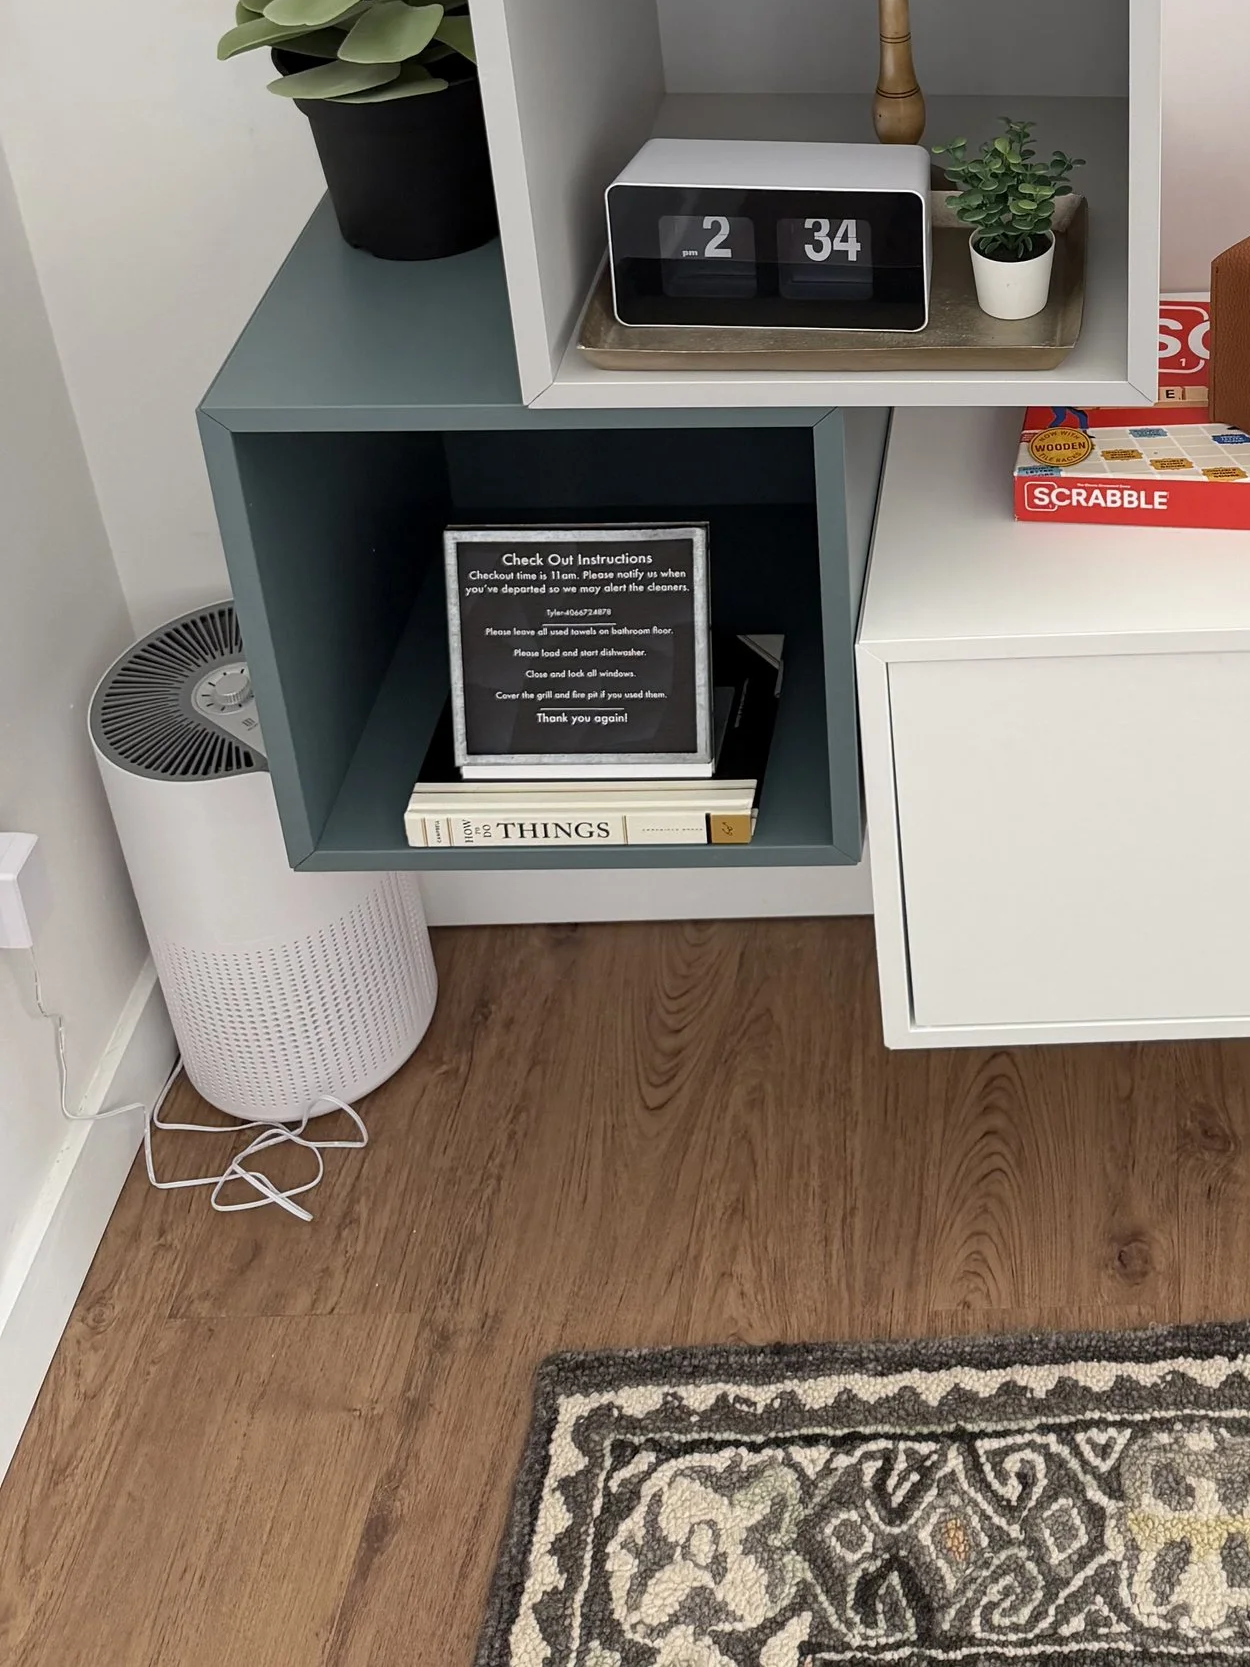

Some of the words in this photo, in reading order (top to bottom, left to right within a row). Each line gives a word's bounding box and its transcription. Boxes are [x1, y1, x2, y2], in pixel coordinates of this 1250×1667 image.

[682, 250, 698, 258] pm
[702, 216, 732, 258] 2
[804, 218, 861, 262] 34
[1060, 430, 1079, 440] WITH
[1035, 442, 1086, 452] WOODEN
[1033, 487, 1169, 509] SCRABBLE
[502, 553, 543, 566] Check
[548, 553, 573, 566] Out
[578, 552, 653, 565] Instructions
[469, 571, 514, 581] Checkout
[516, 572, 537, 580] time
[539, 572, 547, 580] is
[551, 571, 580, 580] 11am.
[583, 571, 614, 580] Please
[617, 569, 644, 581] notify
[647, 571, 658, 579] us
[660, 569, 686, 578] when
[465, 584, 498, 596] you've
[501, 584, 546, 596] departed
[549, 586, 560, 594] so
[563, 586, 577, 594] we
[580, 586, 600, 595] may
[604, 583, 627, 592] alert
[629, 583, 644, 592] the
[647, 583, 690, 592] cleaners.
[485, 628, 511, 636] Please
[513, 628, 535, 636] leave
[571, 627, 597, 635] towels
[611, 626, 650, 635] bathroom
[652, 626, 673, 634] floor.
[513, 649, 539, 657] Please
[541, 649, 560, 657] load
[563, 649, 578, 657] and
[580, 649, 599, 657] start
[600, 648, 647, 657] dishwasher.
[525, 670, 548, 678] Close
[550, 670, 566, 678] and
[568, 670, 584, 678] lock
[599, 669, 636, 677] windows.
[495, 691, 519, 700] Cover
[521, 691, 535, 699] the
[536, 690, 553, 701] grill
[555, 691, 570, 699] and
[572, 690, 585, 699] fire
[587, 690, 598, 701] pit
[600, 690, 606, 699] if
[607, 691, 622, 701] you
[624, 690, 643, 699] used
[645, 690, 668, 699] them.
[536, 712, 568, 723] Thank
[571, 714, 591, 725] you
[594, 712, 628, 725] again!
[462, 818, 474, 843] HOW
[482, 824, 492, 838] DO
[496, 821, 610, 840] THINGS
